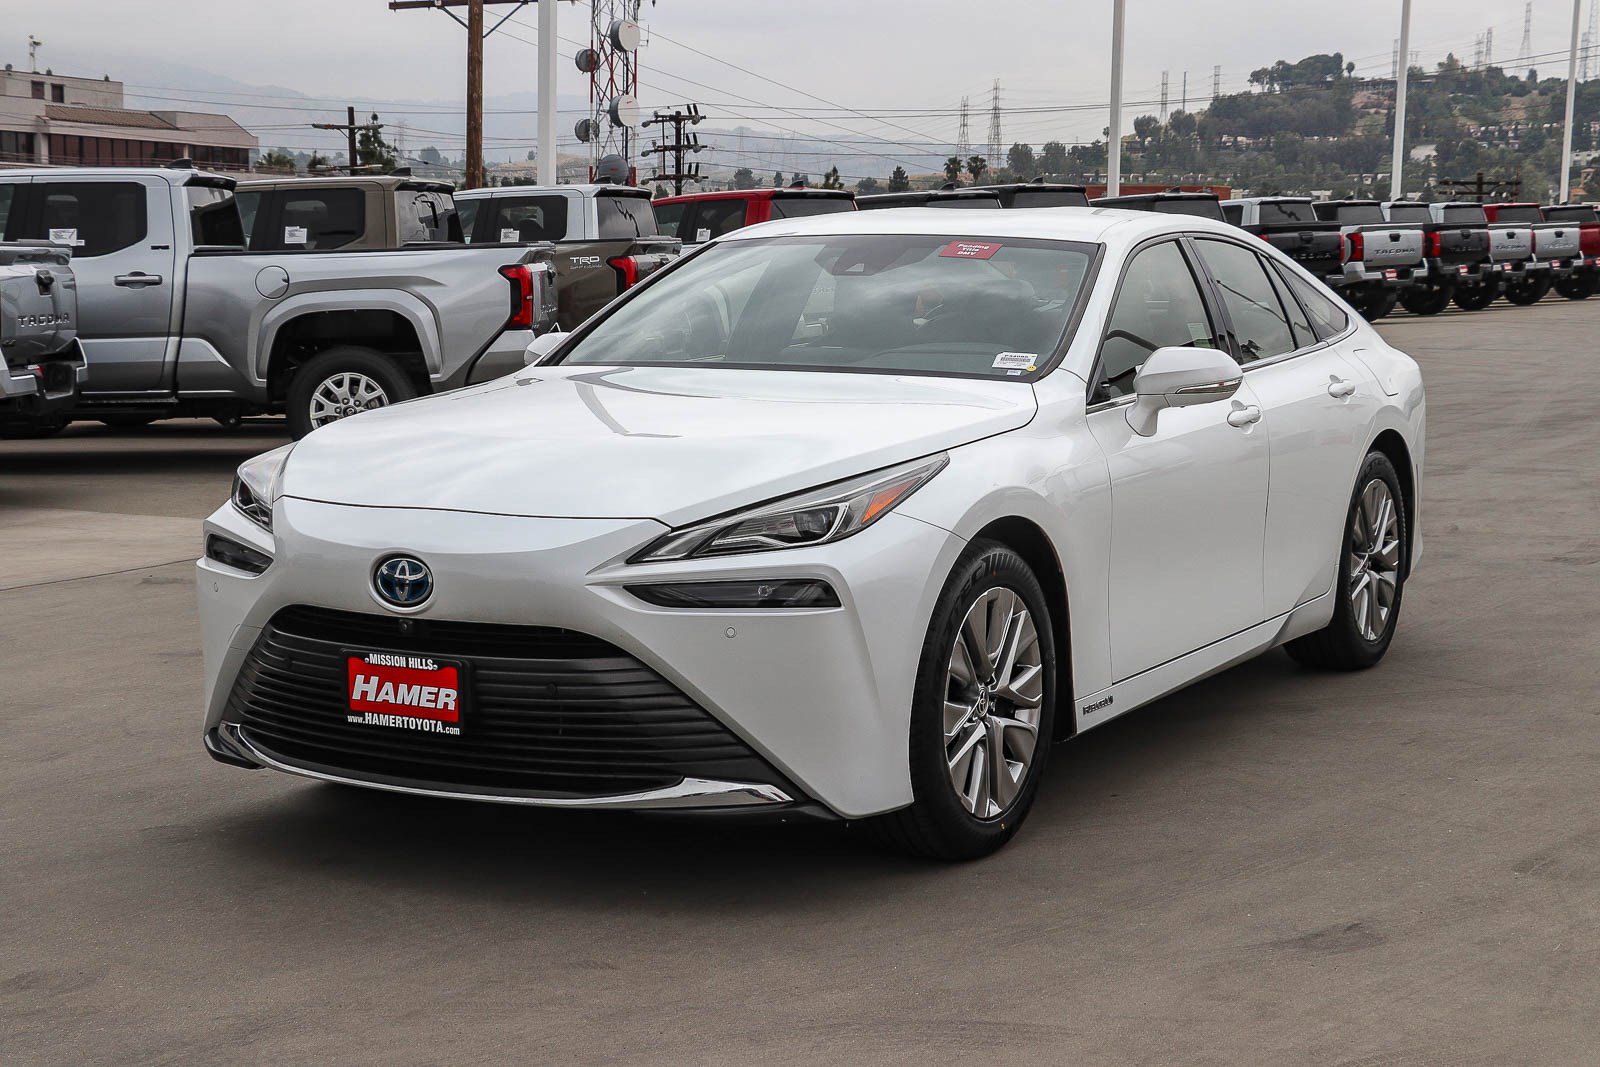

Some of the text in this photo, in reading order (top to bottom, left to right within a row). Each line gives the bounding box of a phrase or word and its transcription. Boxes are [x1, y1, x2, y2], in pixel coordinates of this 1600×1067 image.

[569, 256, 600, 264] TRD
[1374, 248, 1416, 256] TACOMA
[17, 313, 71, 328] TACOMA
[369, 653, 433, 671] MISSION HILLS
[352, 674, 457, 710] HAMER
[347, 712, 460, 735] www.HAMERTOYOTA.com
